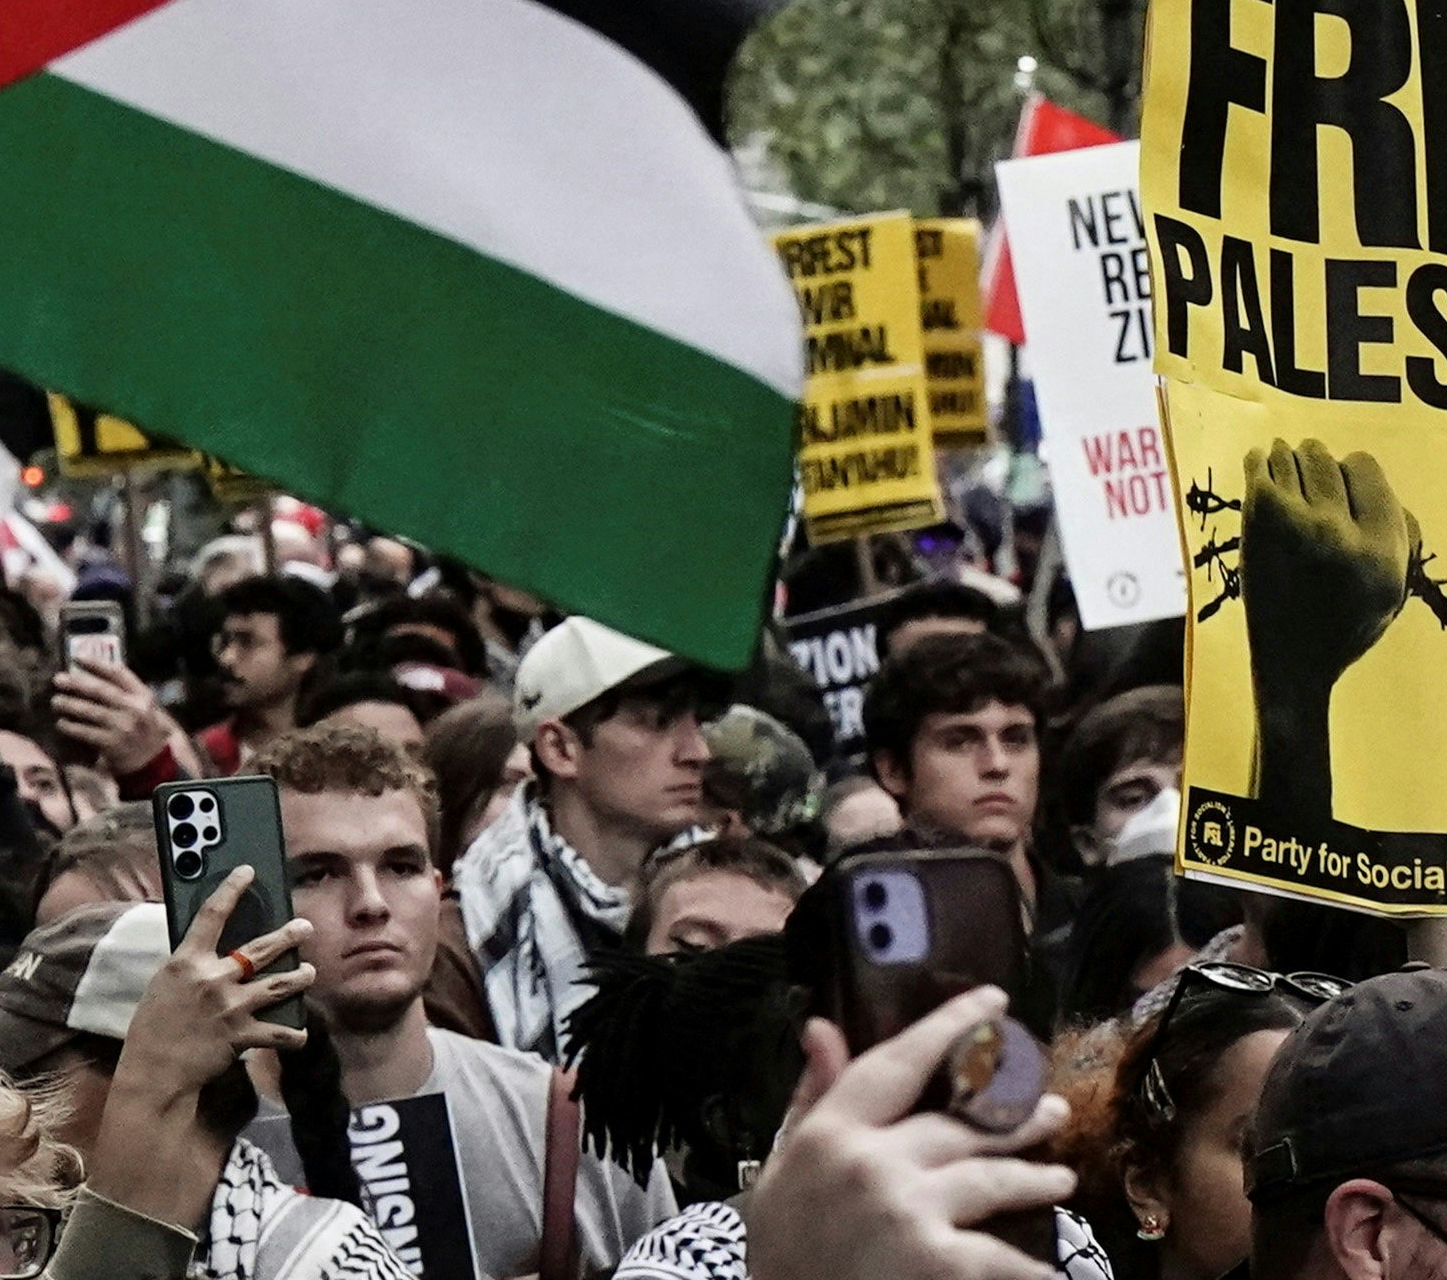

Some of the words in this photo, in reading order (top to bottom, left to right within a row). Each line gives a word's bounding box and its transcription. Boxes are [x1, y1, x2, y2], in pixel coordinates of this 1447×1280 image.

[1082, 426, 1162, 478] WAR
[1103, 470, 1169, 521] NOT
[1243, 825, 1312, 875] Party
[1318, 842, 1351, 879] for
